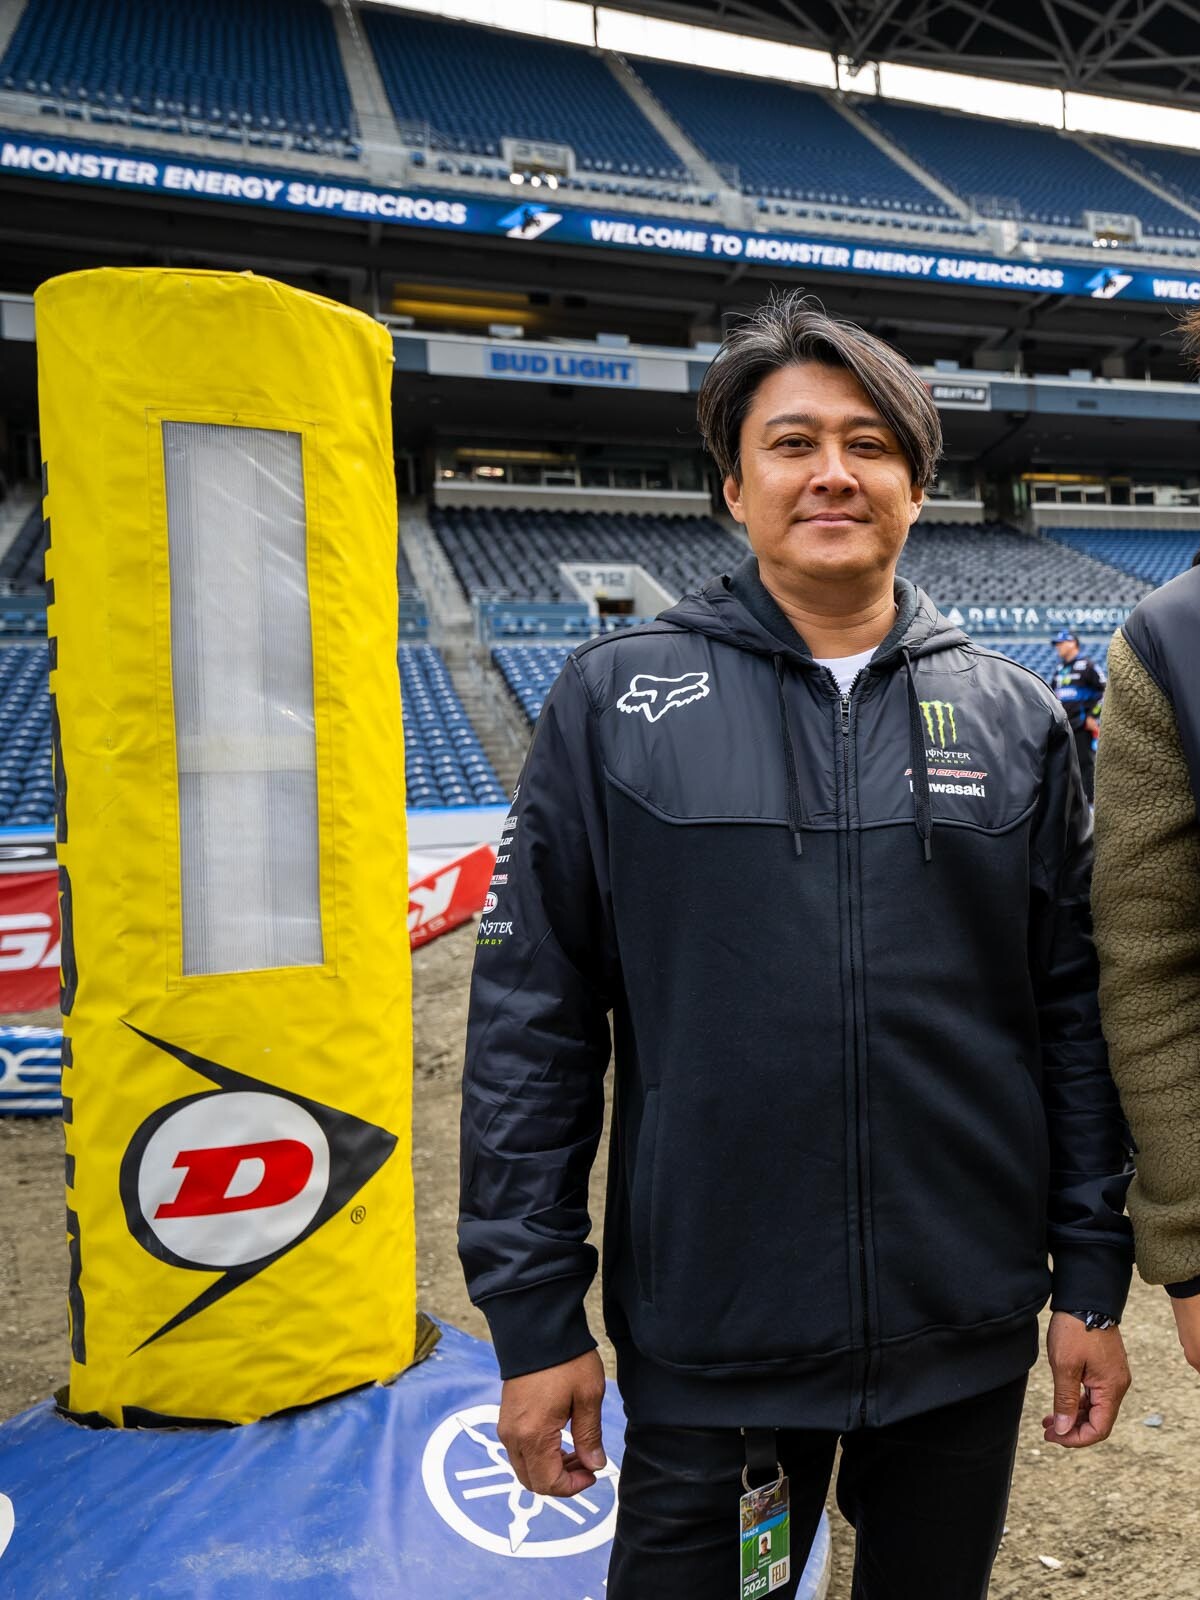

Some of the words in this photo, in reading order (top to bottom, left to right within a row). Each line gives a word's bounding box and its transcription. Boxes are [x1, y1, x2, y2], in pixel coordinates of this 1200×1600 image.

[1, 143, 158, 186] MONSTER
[163, 164, 284, 202] ENERGY
[287, 182, 467, 226] SUPERCROSS
[590, 220, 706, 254] WELCOME
[710, 233, 743, 256] TO
[745, 237, 850, 268] MONSTER
[852, 247, 937, 277] ENERGY
[937, 259, 1065, 290] SUPERCROSS
[490, 351, 549, 374] BUD
[554, 356, 632, 381] LIGHT
[968, 607, 1040, 624] DELTA
[936, 768, 988, 779] CIRCUIT
[909, 780, 985, 798] wasaki
[154, 1139, 314, 1220] D
[743, 1576, 767, 1598] 2022
